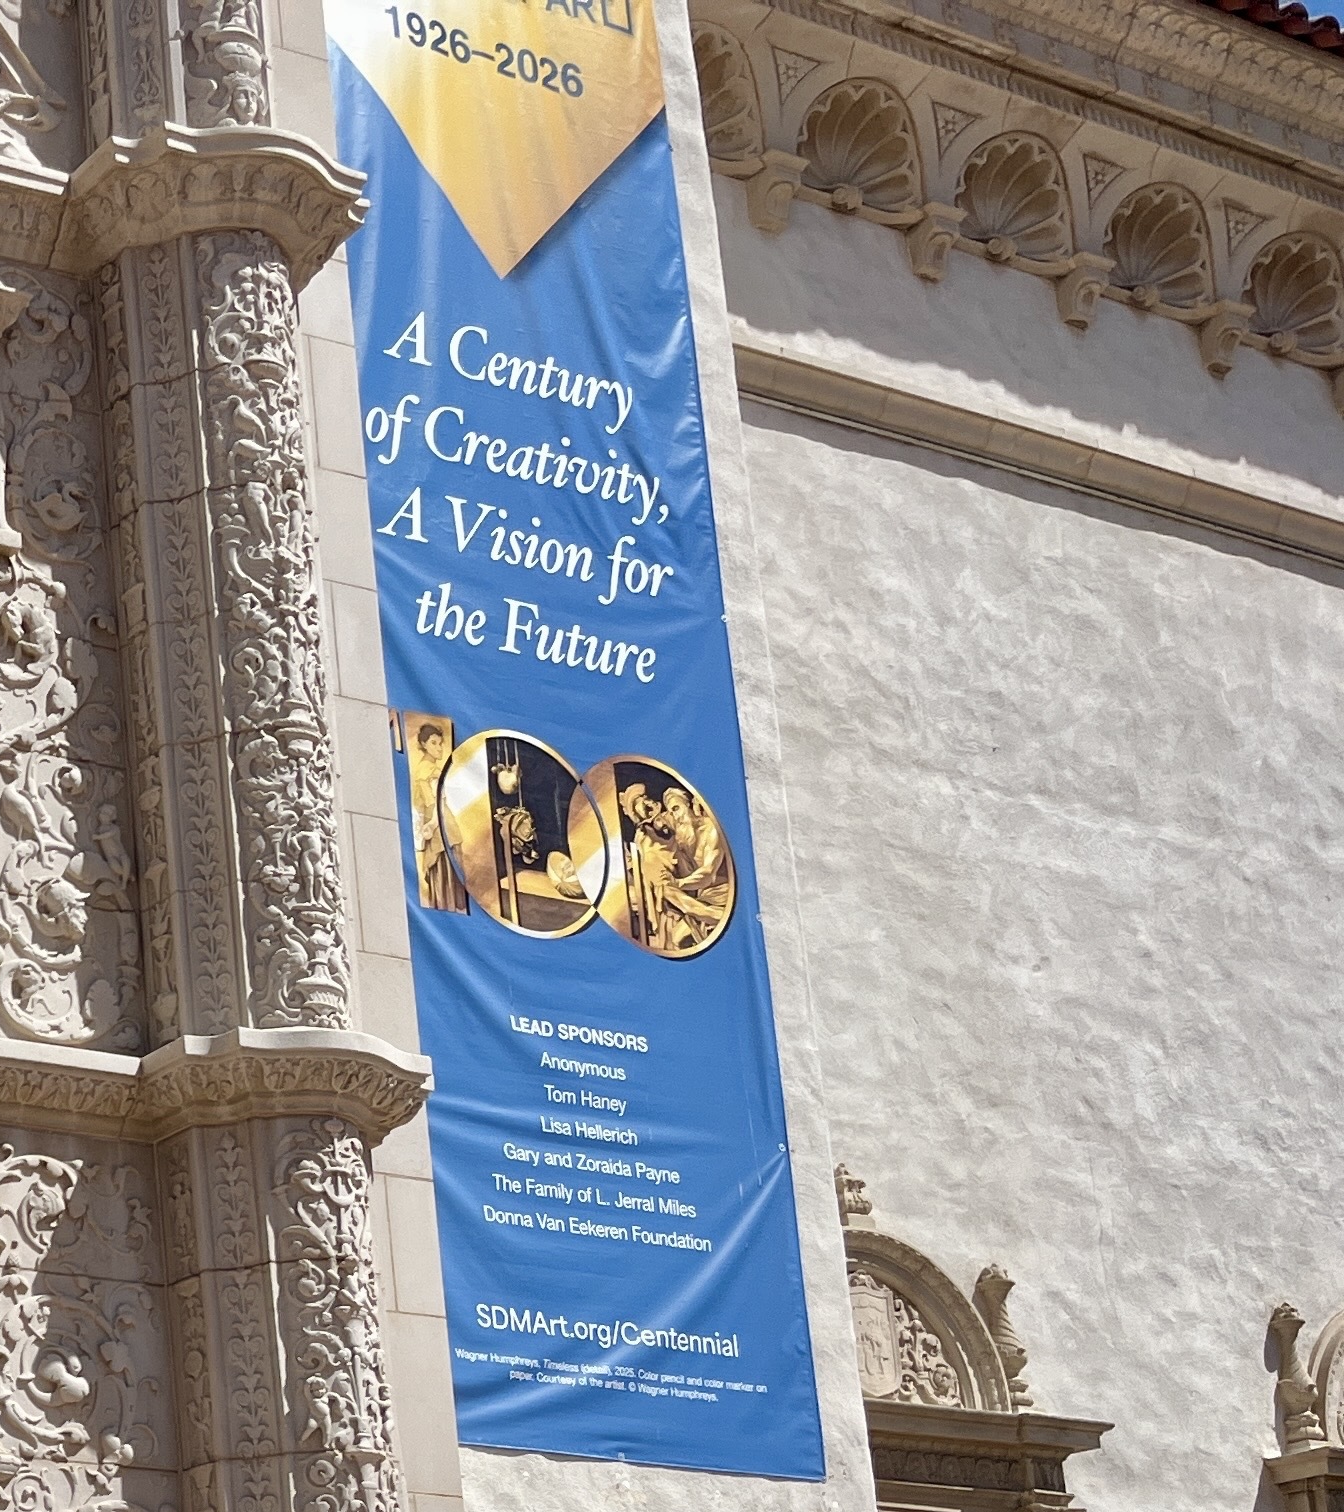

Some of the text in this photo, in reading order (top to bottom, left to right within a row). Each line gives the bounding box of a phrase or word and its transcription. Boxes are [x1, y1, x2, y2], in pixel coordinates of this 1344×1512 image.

[383, 311, 633, 434] A Century
[365, 395, 669, 525] of Creativity,
[376, 487, 674, 605] A Vision for
[415, 582, 657, 683] the Future
[509, 1014, 649, 1053] LEAD SPONSORS
[540, 1051, 626, 1081] Anonymous
[543, 1084, 627, 1116] Tom Haney
[539, 1115, 638, 1146] Lisa Hellerich
[503, 1142, 680, 1185] Gary and Zoraida Payne
[491, 1173, 697, 1219] The Family of L. Jerral Miles
[483, 1204, 712, 1253] Donna Van Eekeren Foundation
[476, 1303, 740, 1357] SDMArt.org/Centennial
[455, 1348, 488, 1363] Wagner
[686, 1377, 703, 1387] and
[755, 1384, 768, 1393] on
[536, 1372, 576, 1387] Courtesy
[578, 1376, 588, 1386] of
[589, 1377, 604, 1388] the
[637, 1383, 668, 1397] Wagner
